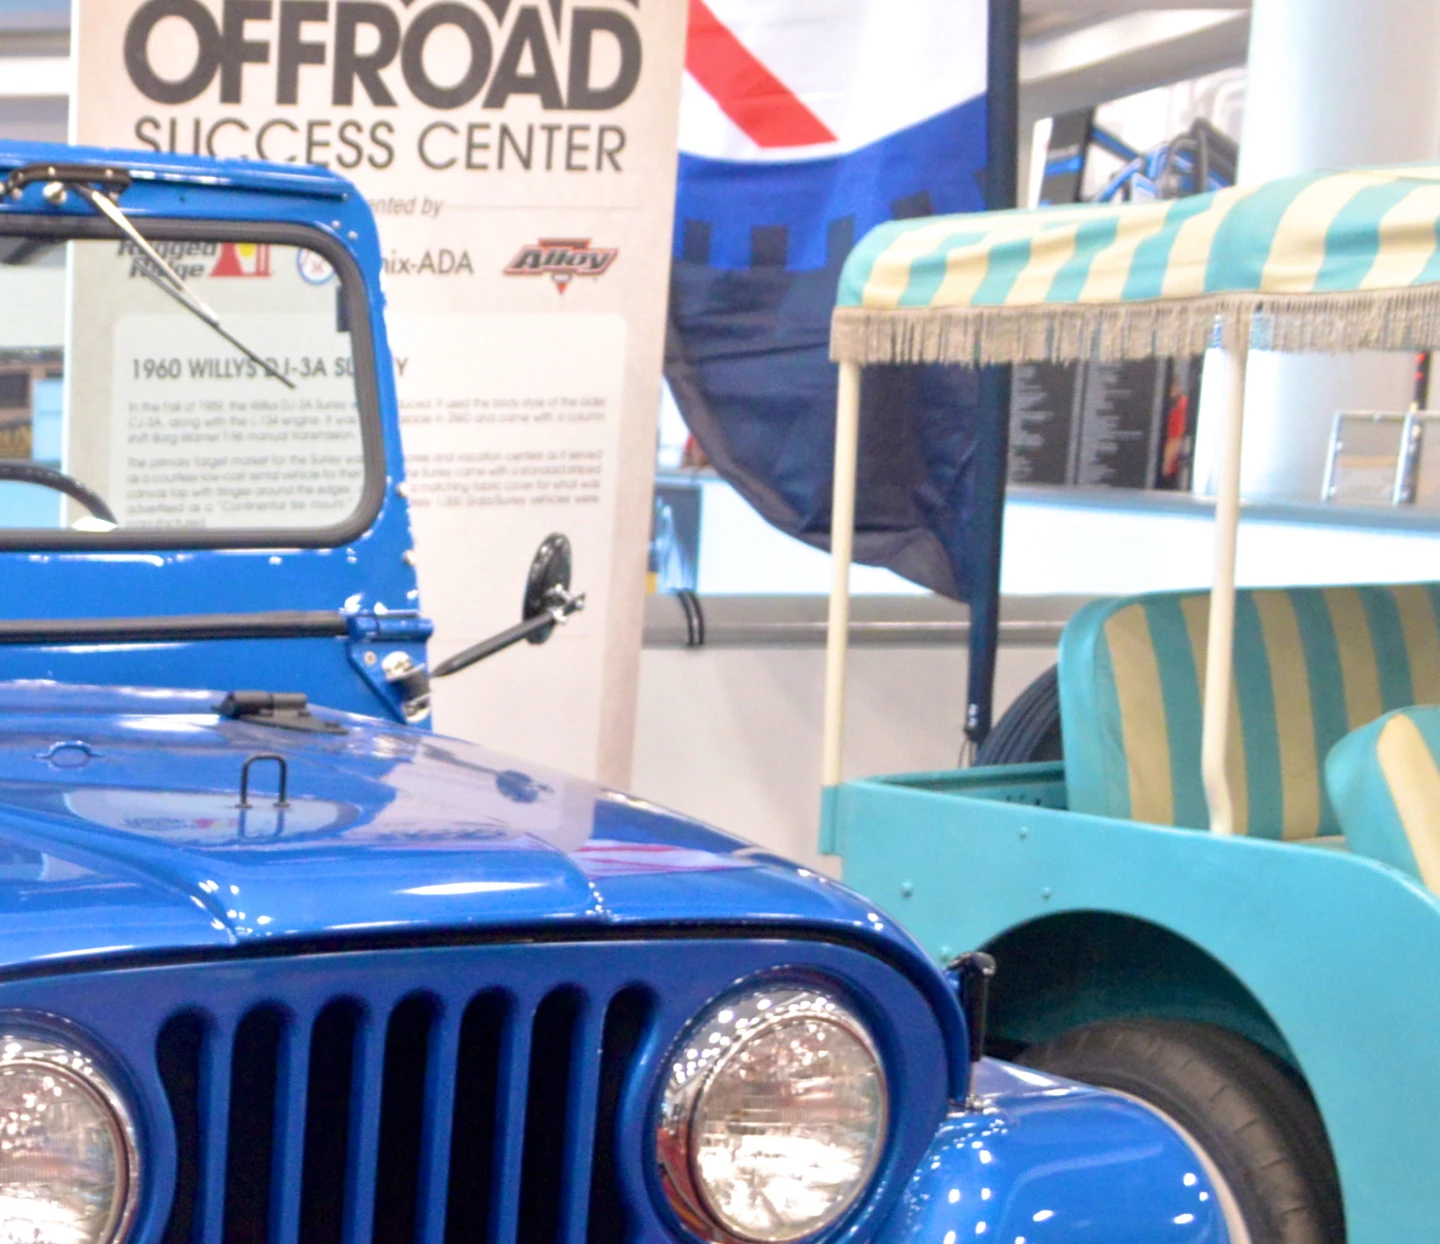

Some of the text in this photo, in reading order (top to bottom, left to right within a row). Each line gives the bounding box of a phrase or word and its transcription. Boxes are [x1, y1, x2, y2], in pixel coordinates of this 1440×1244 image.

[123, 0, 642, 110] OFFROAD
[134, 116, 627, 172] SUCCESS CENTER
[369, 196, 443, 219] ented by
[129, 256, 205, 280] Rge
[383, 249, 474, 275] ix-ADA
[515, 249, 612, 270] Alloy
[132, 359, 181, 380] 1960
[188, 357, 257, 379] WILLYS
